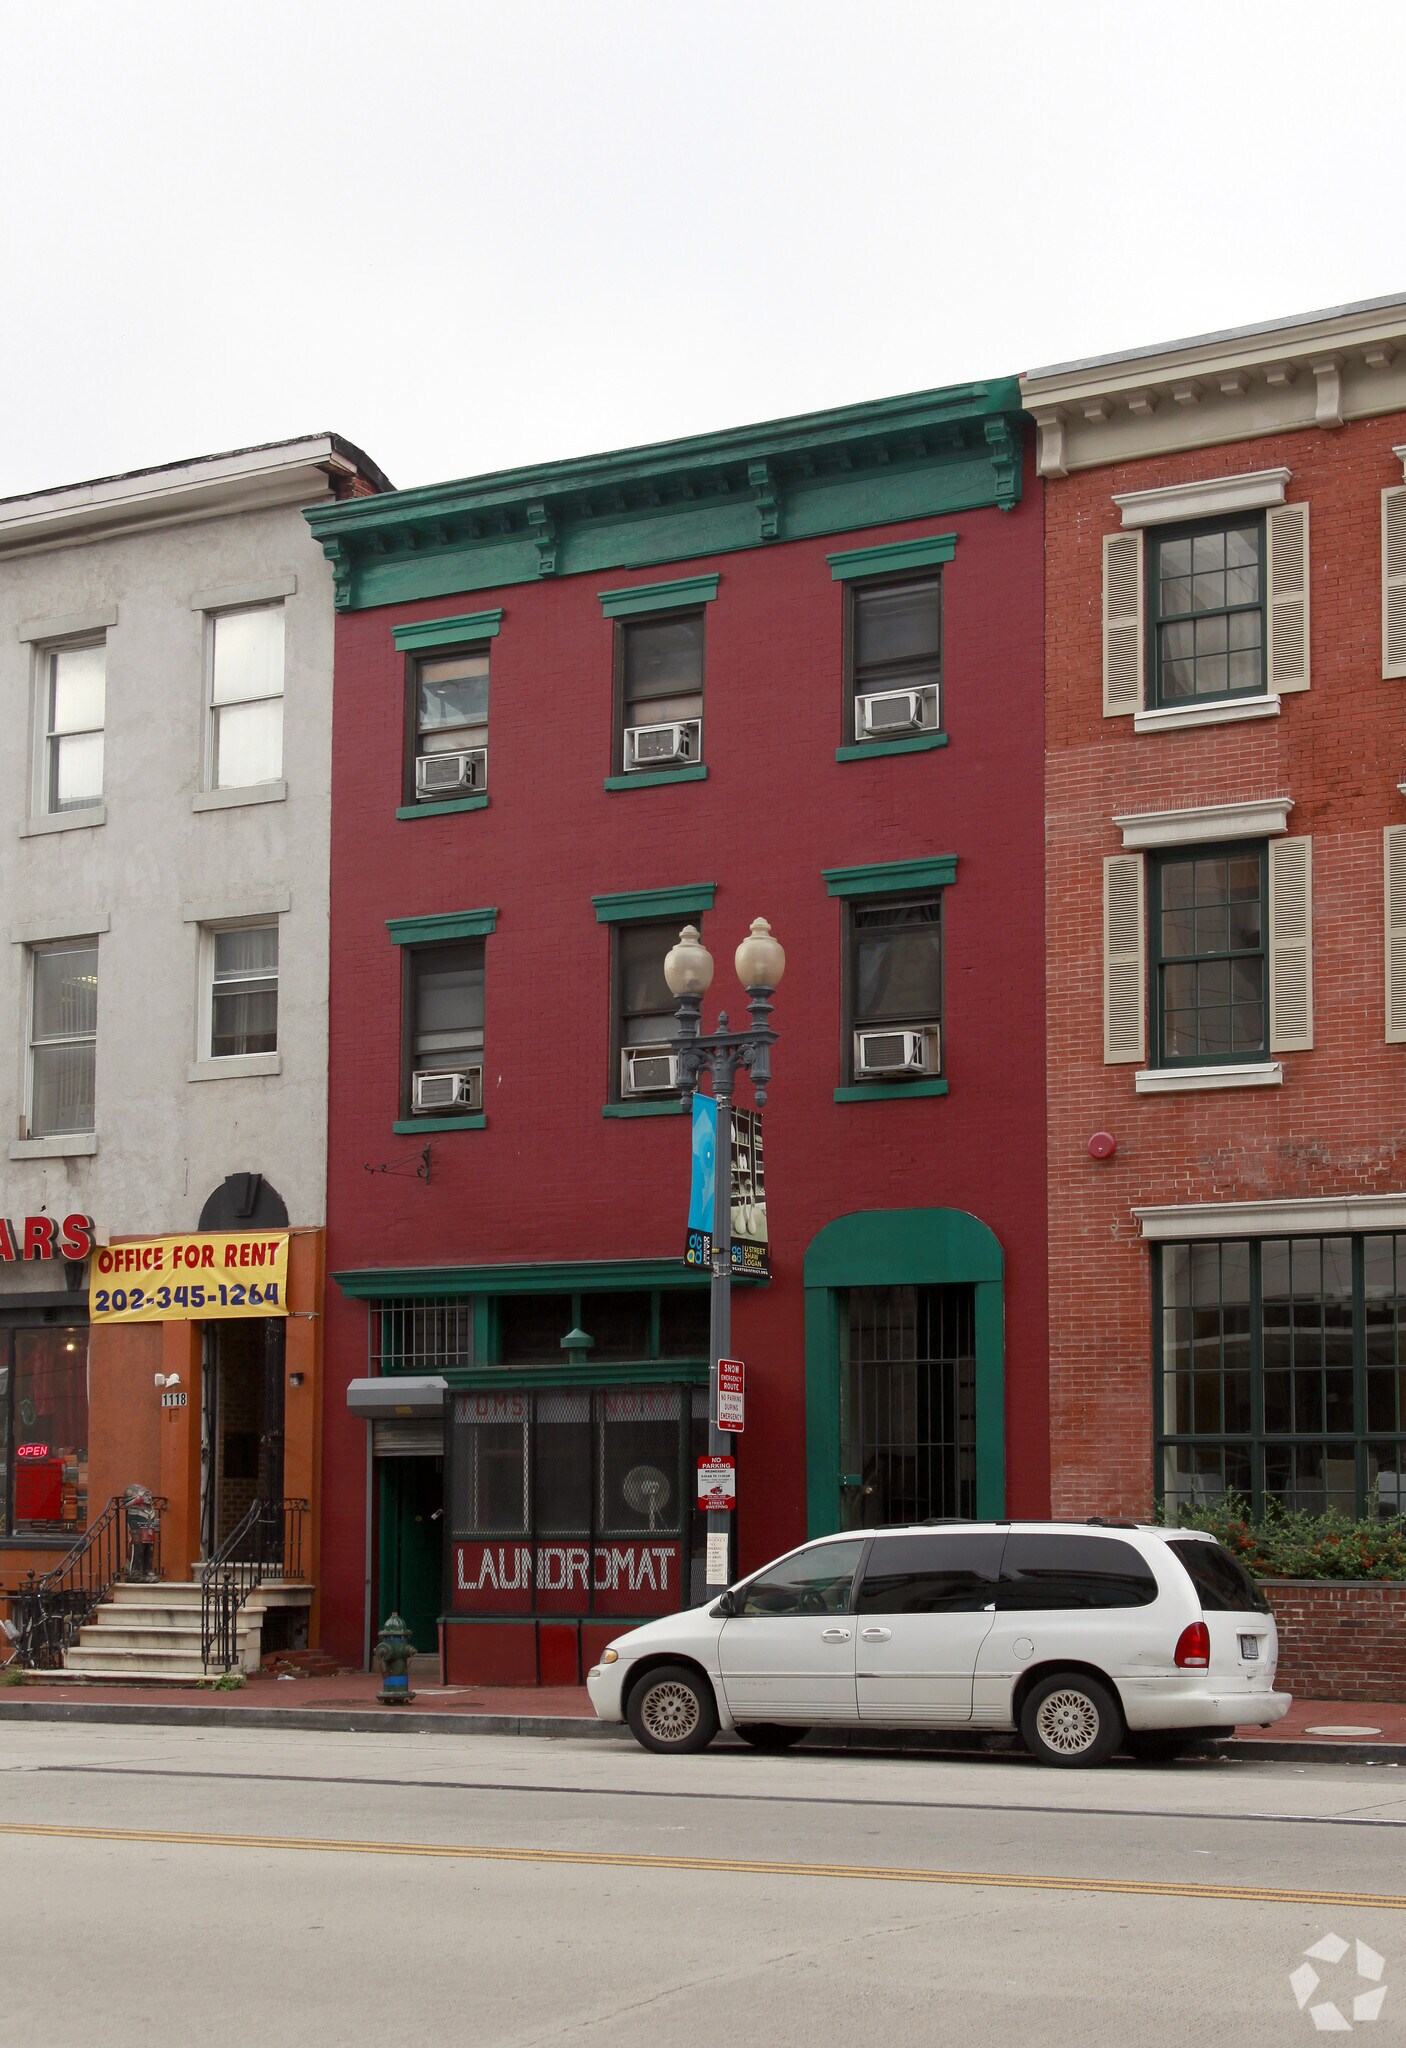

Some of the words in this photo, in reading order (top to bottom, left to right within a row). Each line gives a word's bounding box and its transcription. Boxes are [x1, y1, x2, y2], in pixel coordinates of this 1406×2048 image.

[749, 1246, 766, 1256] STREET
[98, 1246, 163, 1274] OFFICE
[172, 1244, 214, 1270] FOR
[224, 1242, 280, 1268] RENT
[744, 1260, 762, 1268] LOGAN
[95, 1282, 280, 1312] 202-345-1264
[724, 1364, 740, 1374] SNOW
[720, 1374, 742, 1382] EMERGENCY
[724, 1382, 740, 1391] ROUTE
[162, 1393, 187, 1406] 1118
[720, 1412, 742, 1420] EMERGENCY
[17, 1445, 48, 1456] OPEN
[458, 1548, 676, 1590] LAUNDROMAT
